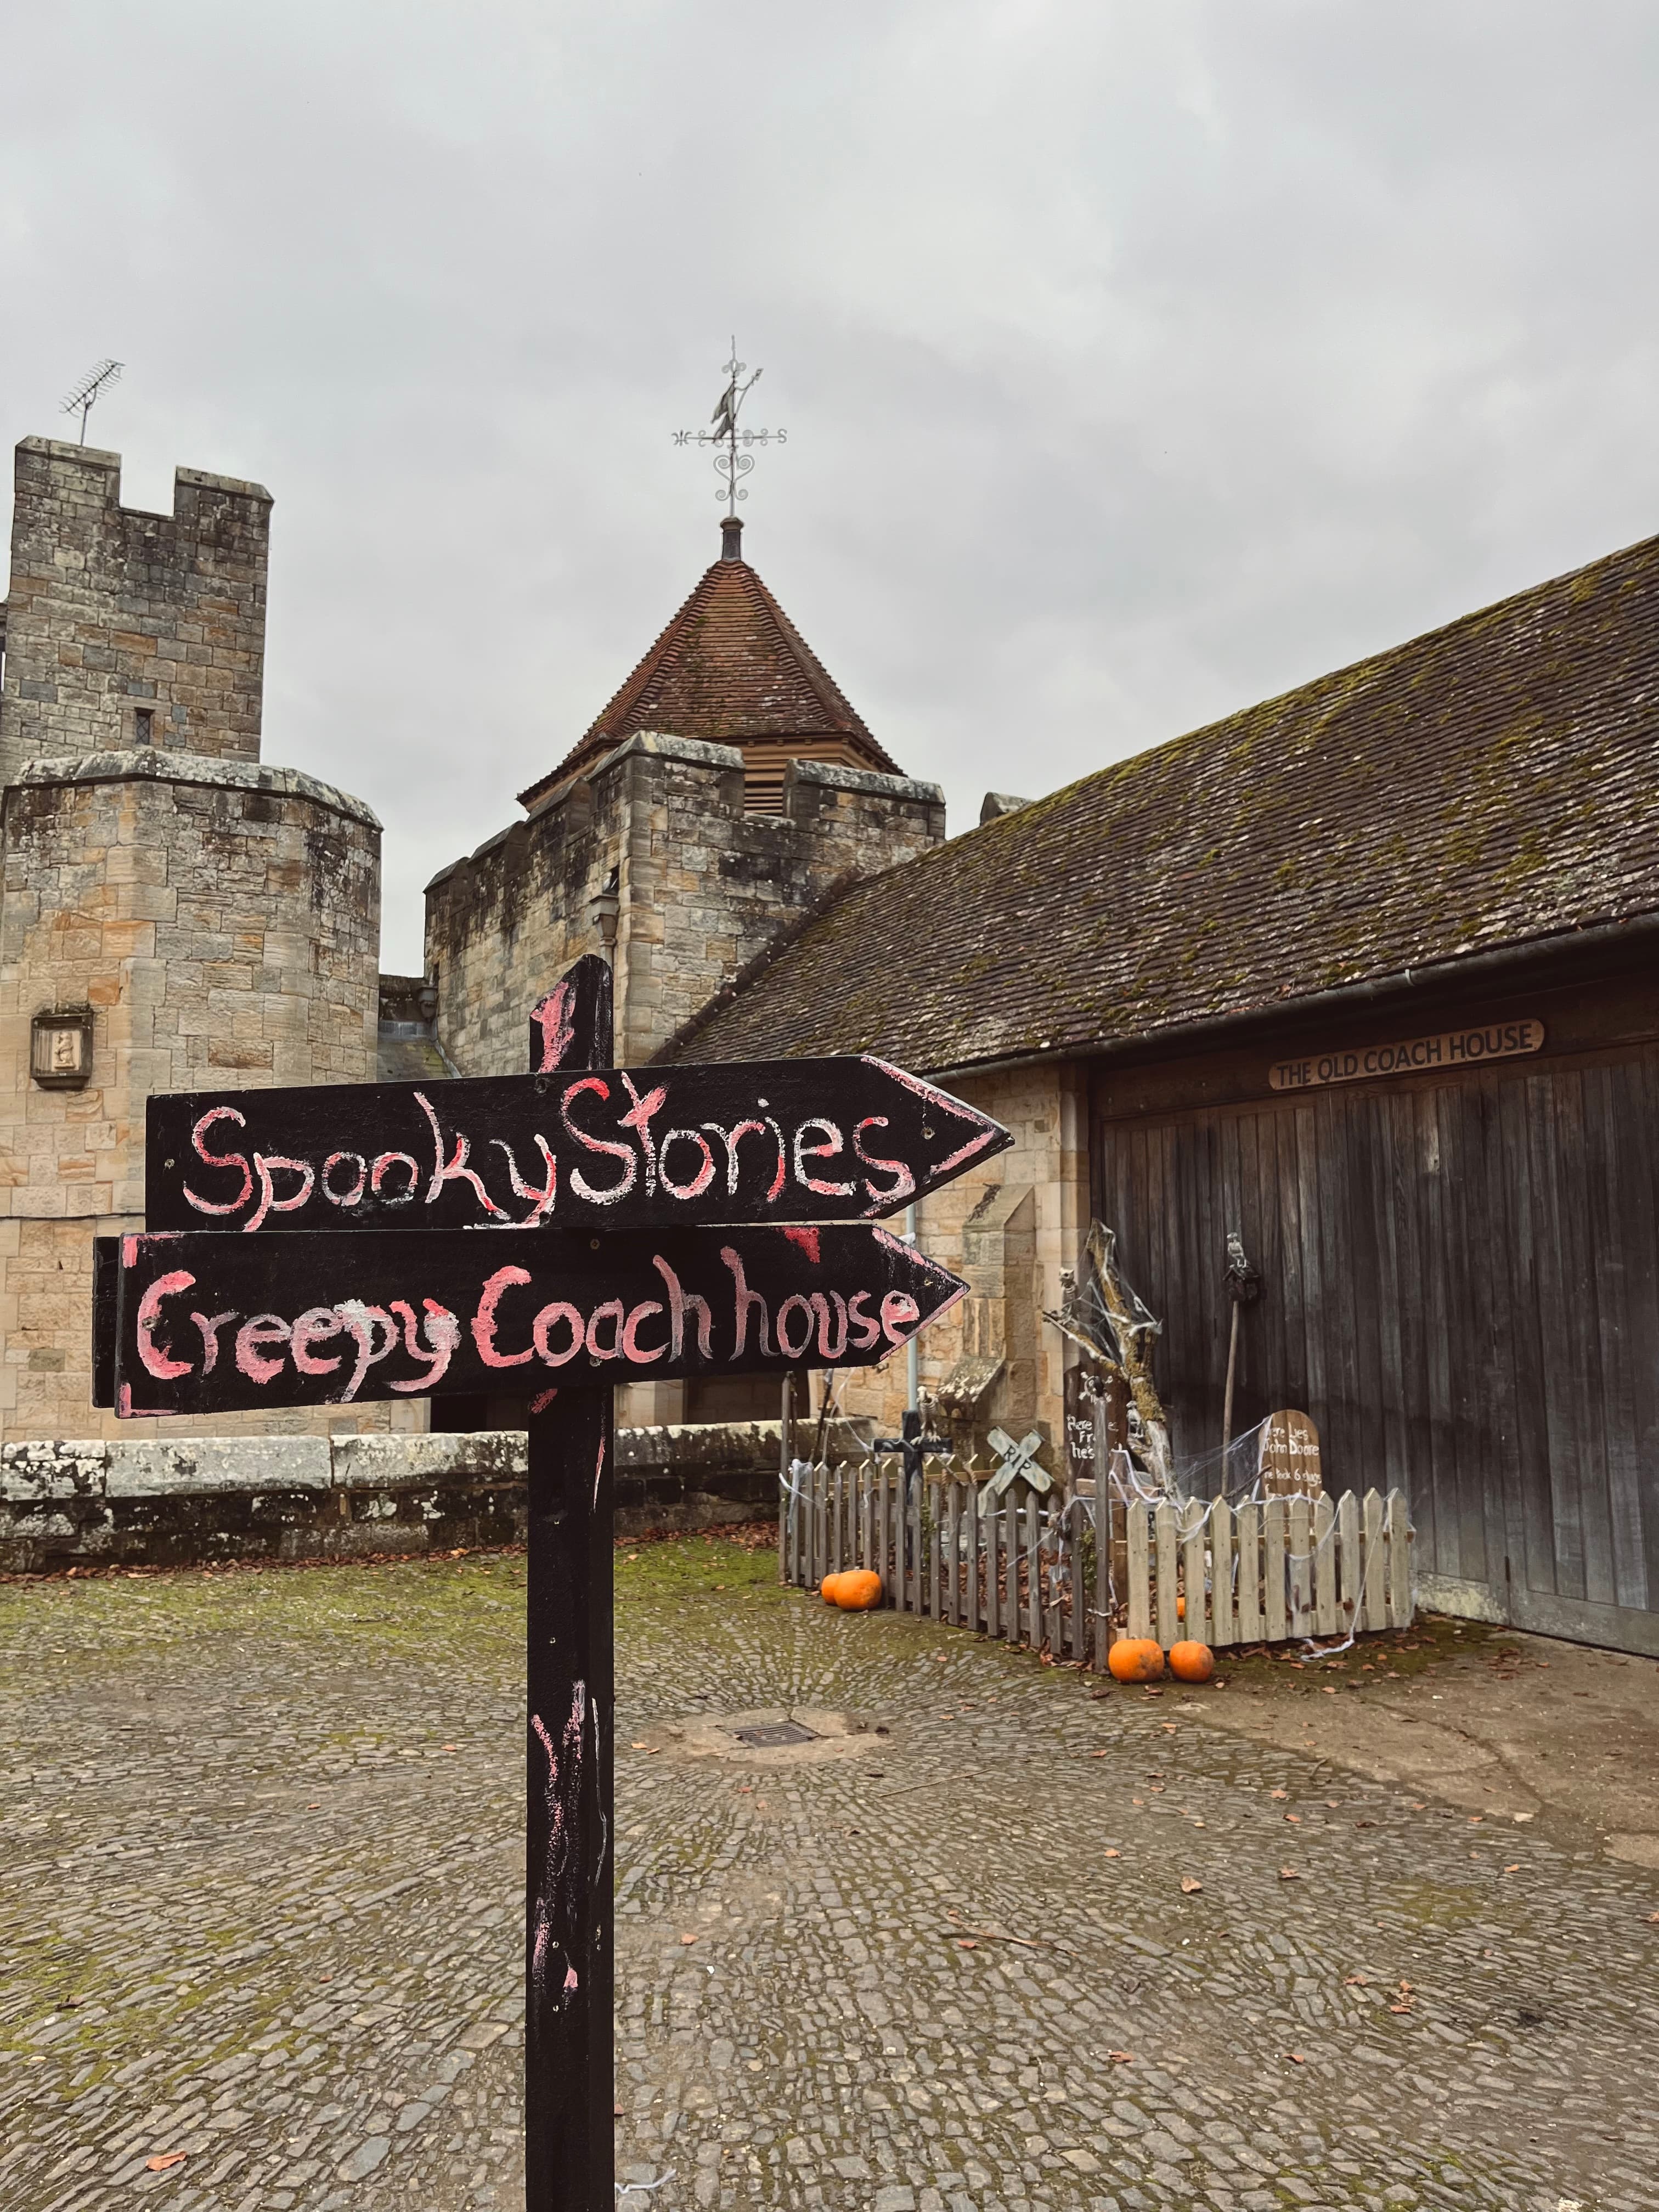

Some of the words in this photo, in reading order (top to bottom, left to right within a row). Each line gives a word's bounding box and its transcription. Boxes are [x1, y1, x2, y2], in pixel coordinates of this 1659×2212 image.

[1277, 1062, 1311, 1086] THE
[1318, 1054, 1358, 1080] OLD
[1364, 1039, 1442, 1073] COACH
[1449, 1023, 1533, 1060] HOUSE
[182, 1091, 557, 1232] Spooky
[560, 1071, 916, 1205] Stories
[137, 1269, 463, 1404] Creepy
[1003, 1444, 1032, 1476] RIP
[1294, 1468, 1301, 1481] 6
